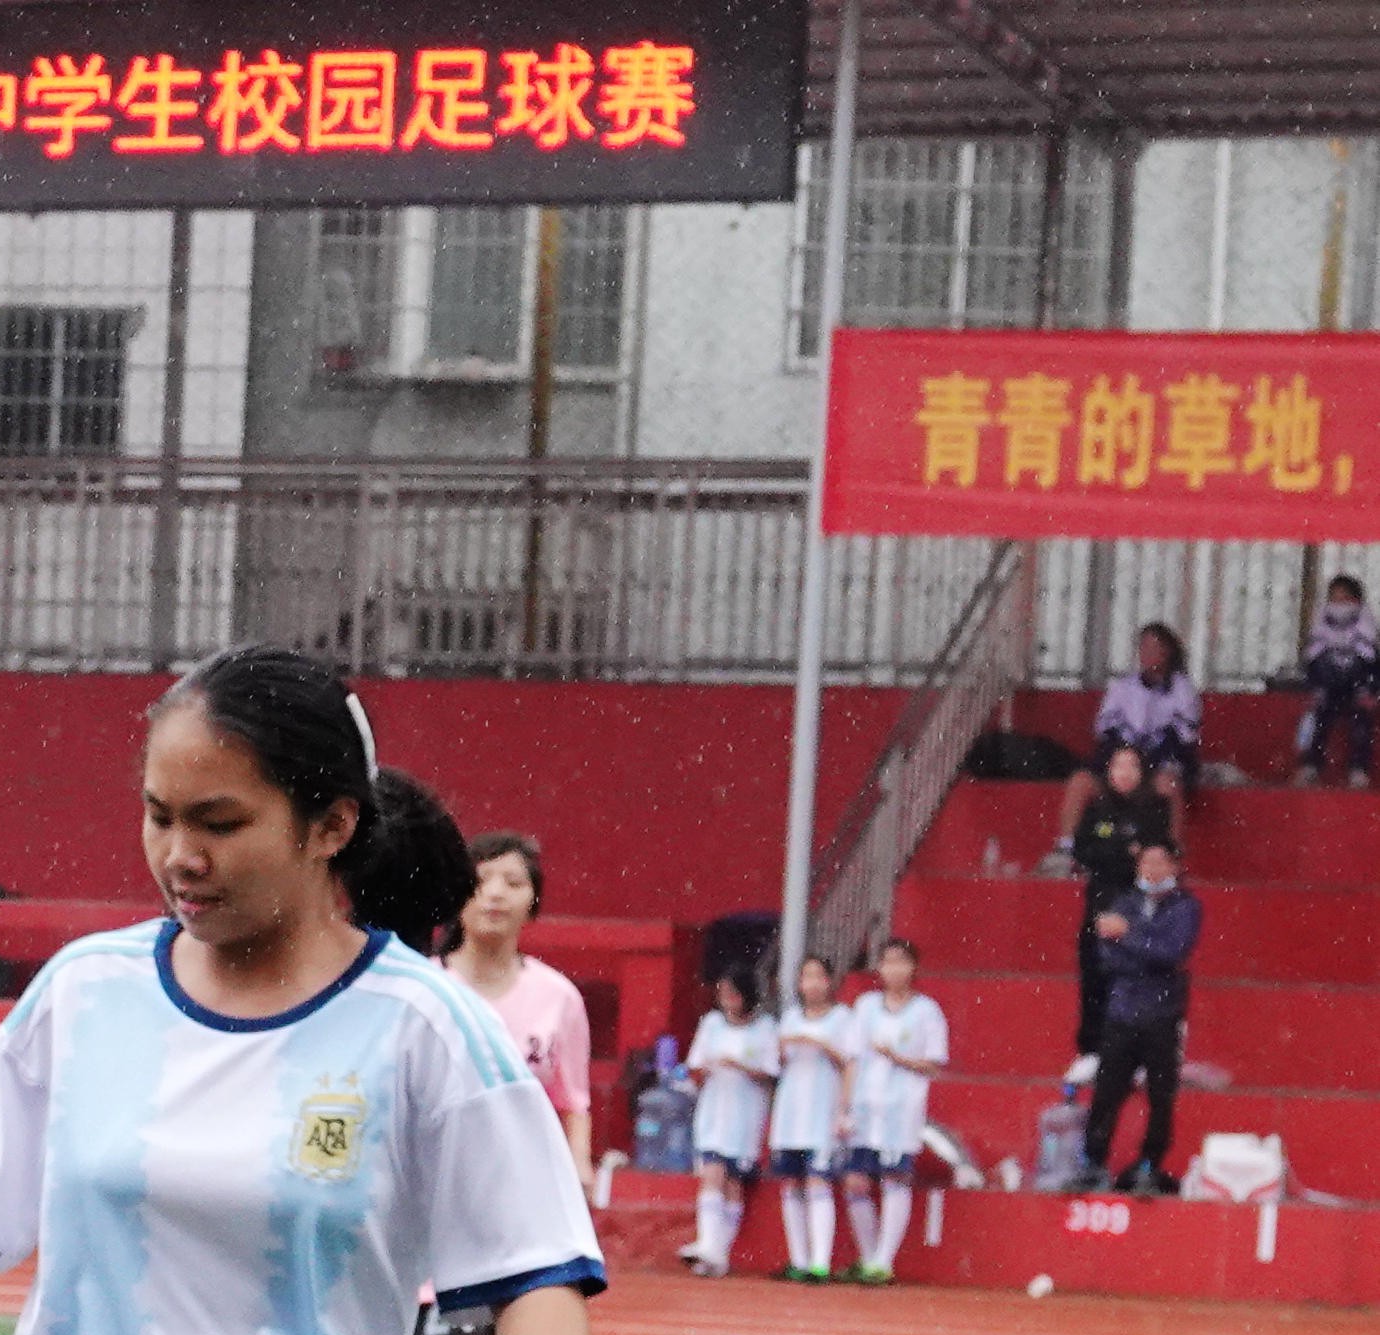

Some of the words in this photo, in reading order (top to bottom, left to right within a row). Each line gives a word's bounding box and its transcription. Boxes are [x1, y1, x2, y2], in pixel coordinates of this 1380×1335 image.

[916, 371, 1354, 494] 青青的草地，
